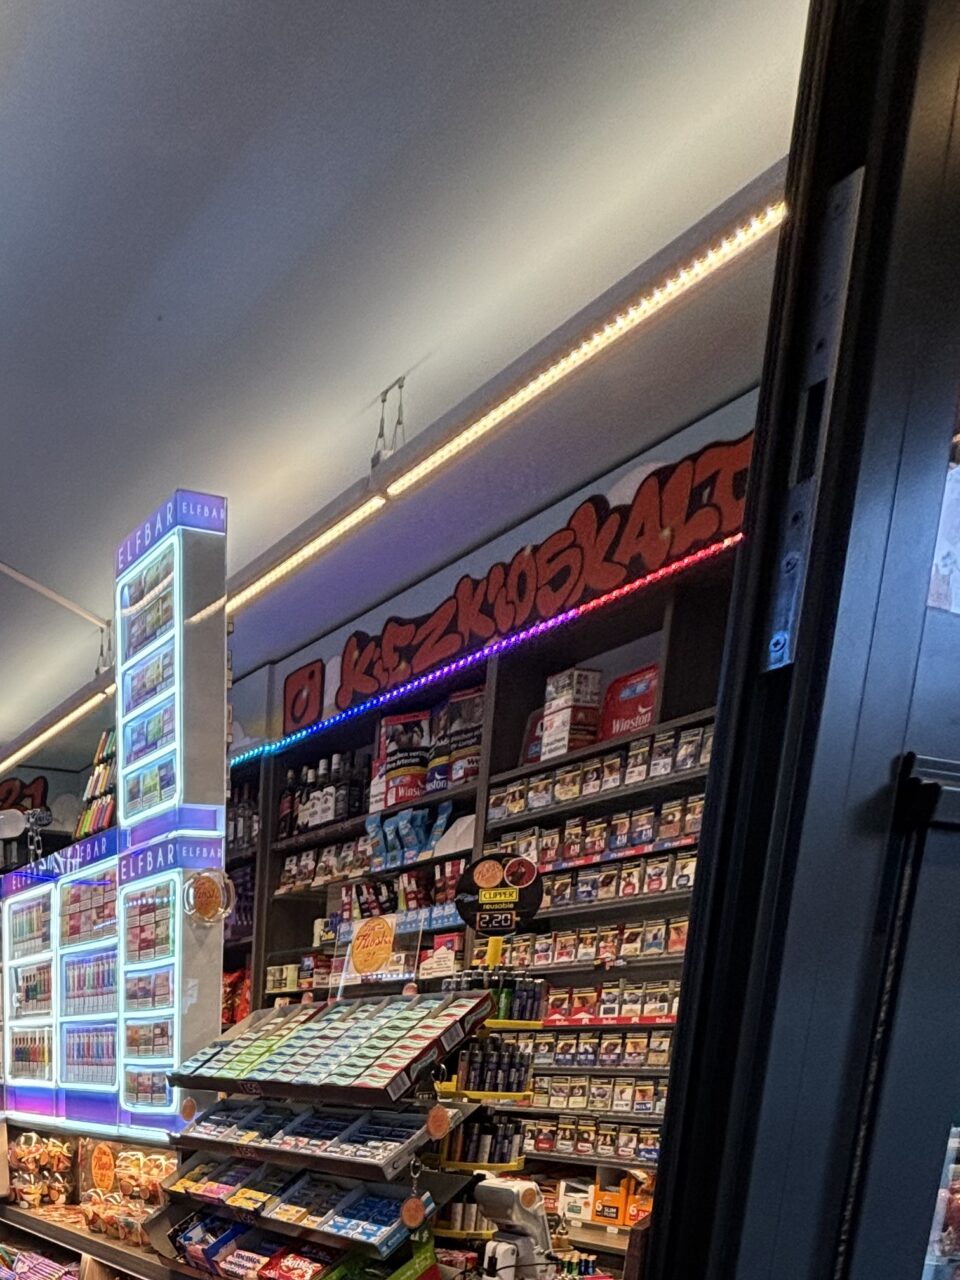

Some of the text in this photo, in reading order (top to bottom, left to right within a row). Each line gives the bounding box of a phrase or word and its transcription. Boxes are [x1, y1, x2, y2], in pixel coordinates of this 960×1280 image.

[182, 502, 224, 519] ELFBAR
[118, 502, 173, 570] ELFBAR
[611, 711, 652, 734] Winston
[121, 845, 176, 881] ELFBAR
[182, 846, 223, 859] ELFBAR
